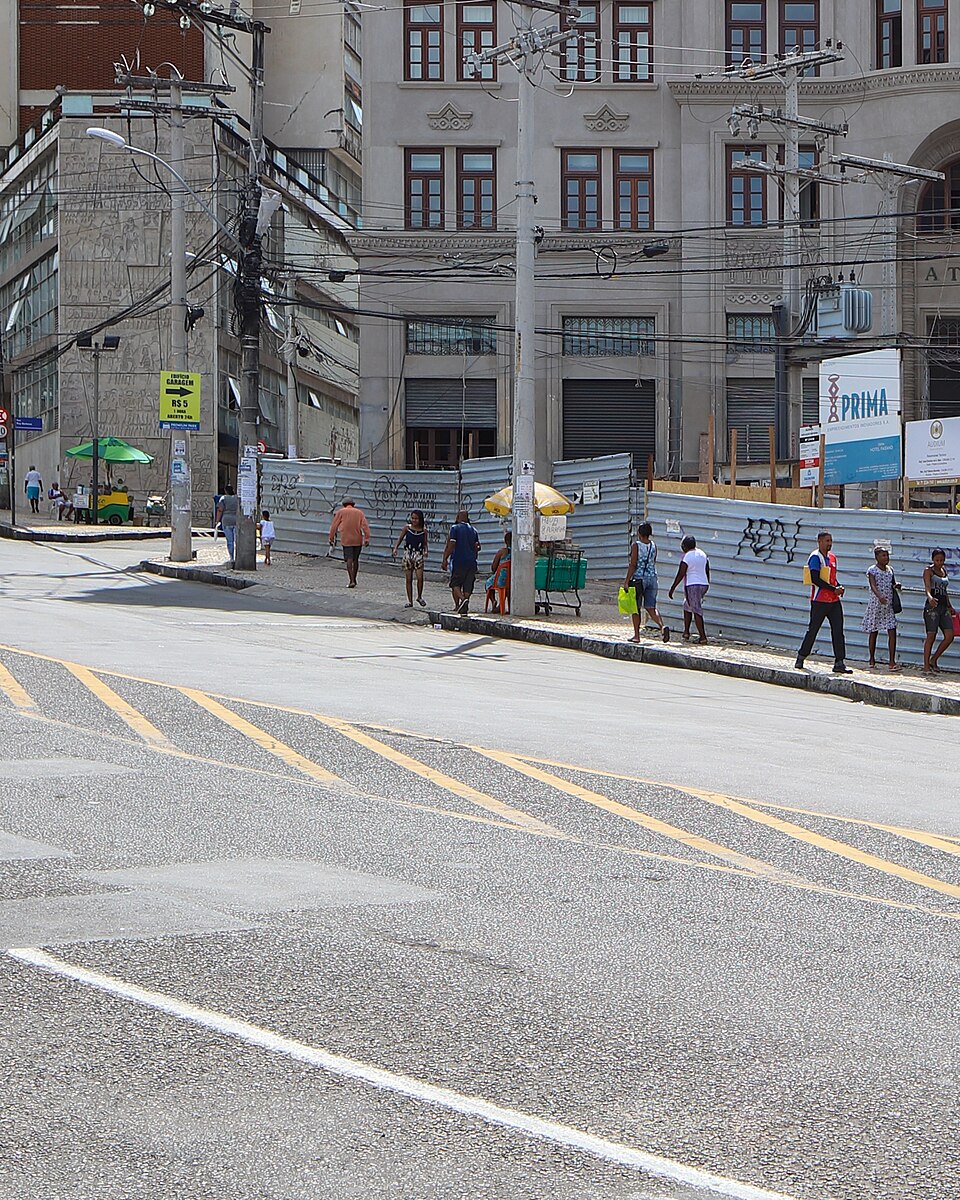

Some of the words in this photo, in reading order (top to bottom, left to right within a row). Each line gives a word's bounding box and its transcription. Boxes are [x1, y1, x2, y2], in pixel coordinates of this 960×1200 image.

[925, 267, 938, 281] A
[171, 399, 182, 408] R$
[183, 399, 189, 408] 5
[841, 387, 889, 422] PRIMA
